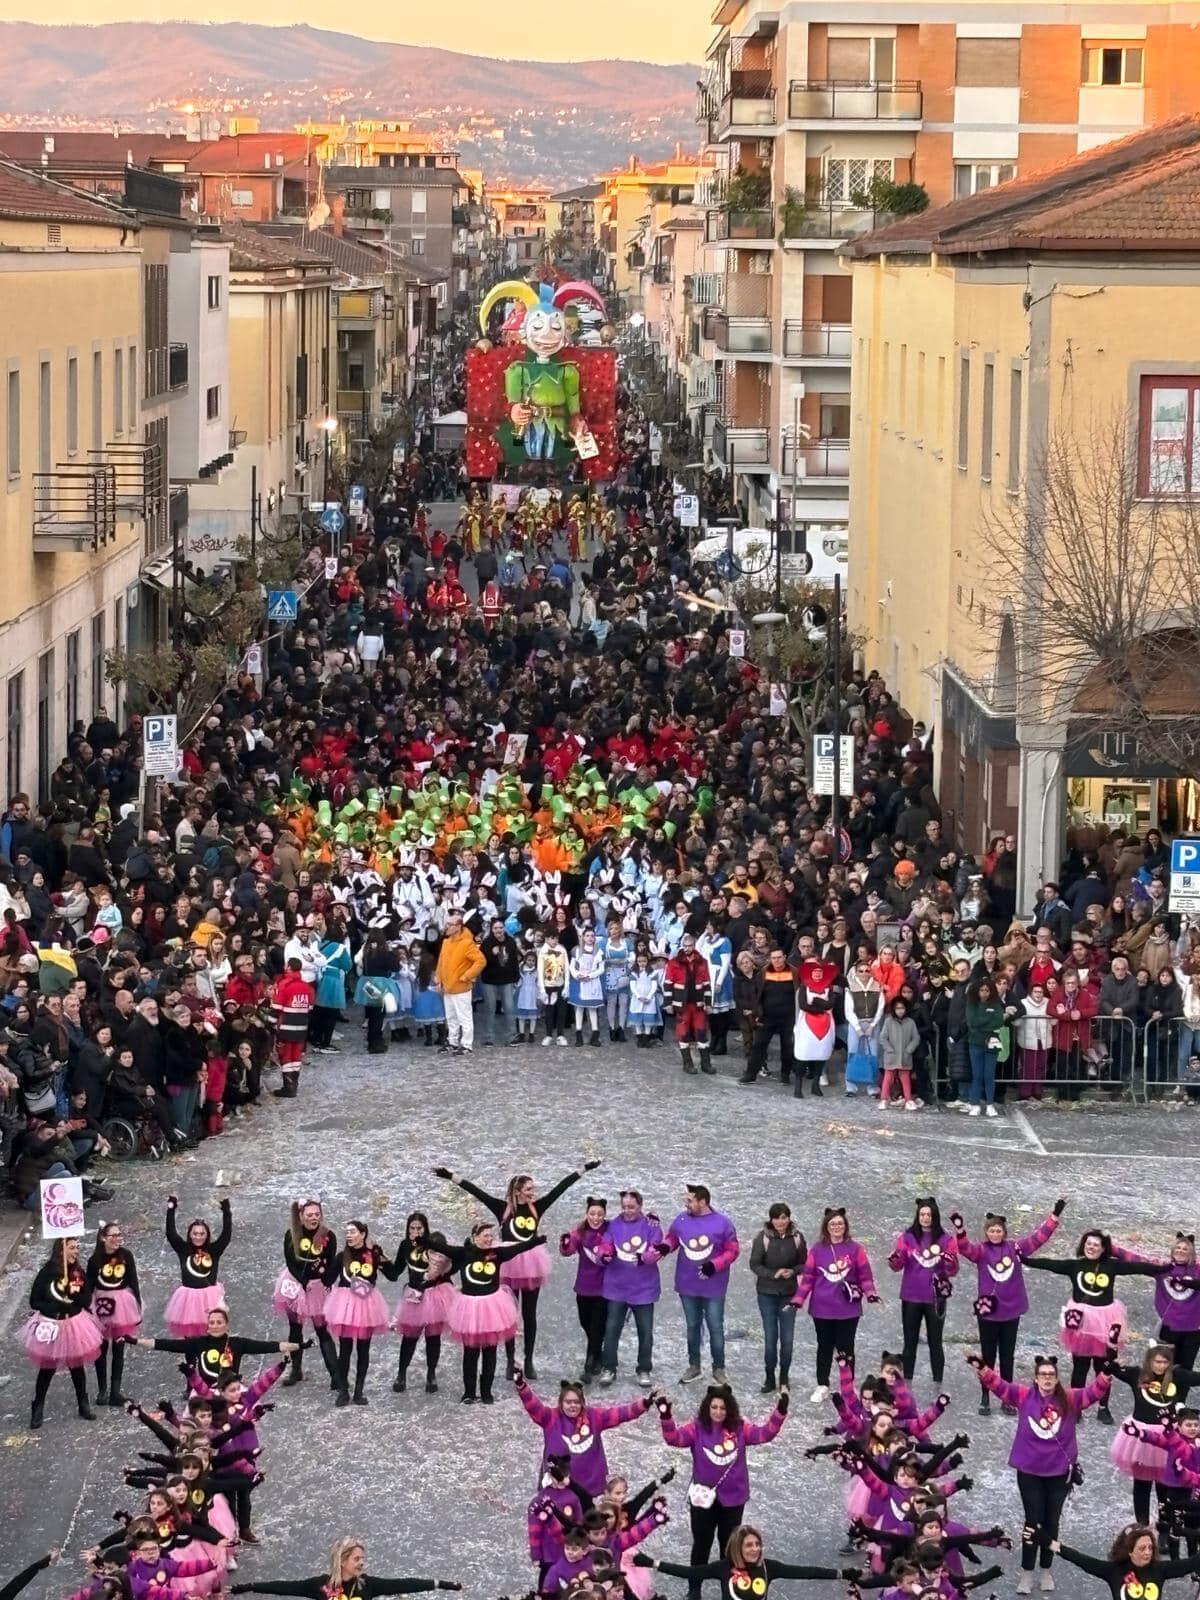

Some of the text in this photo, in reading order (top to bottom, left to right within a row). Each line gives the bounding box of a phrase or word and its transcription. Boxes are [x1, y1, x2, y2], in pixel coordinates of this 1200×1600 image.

[148, 720, 162, 740] P
[821, 739, 834, 756] P
[1179, 845, 1198, 868] P
